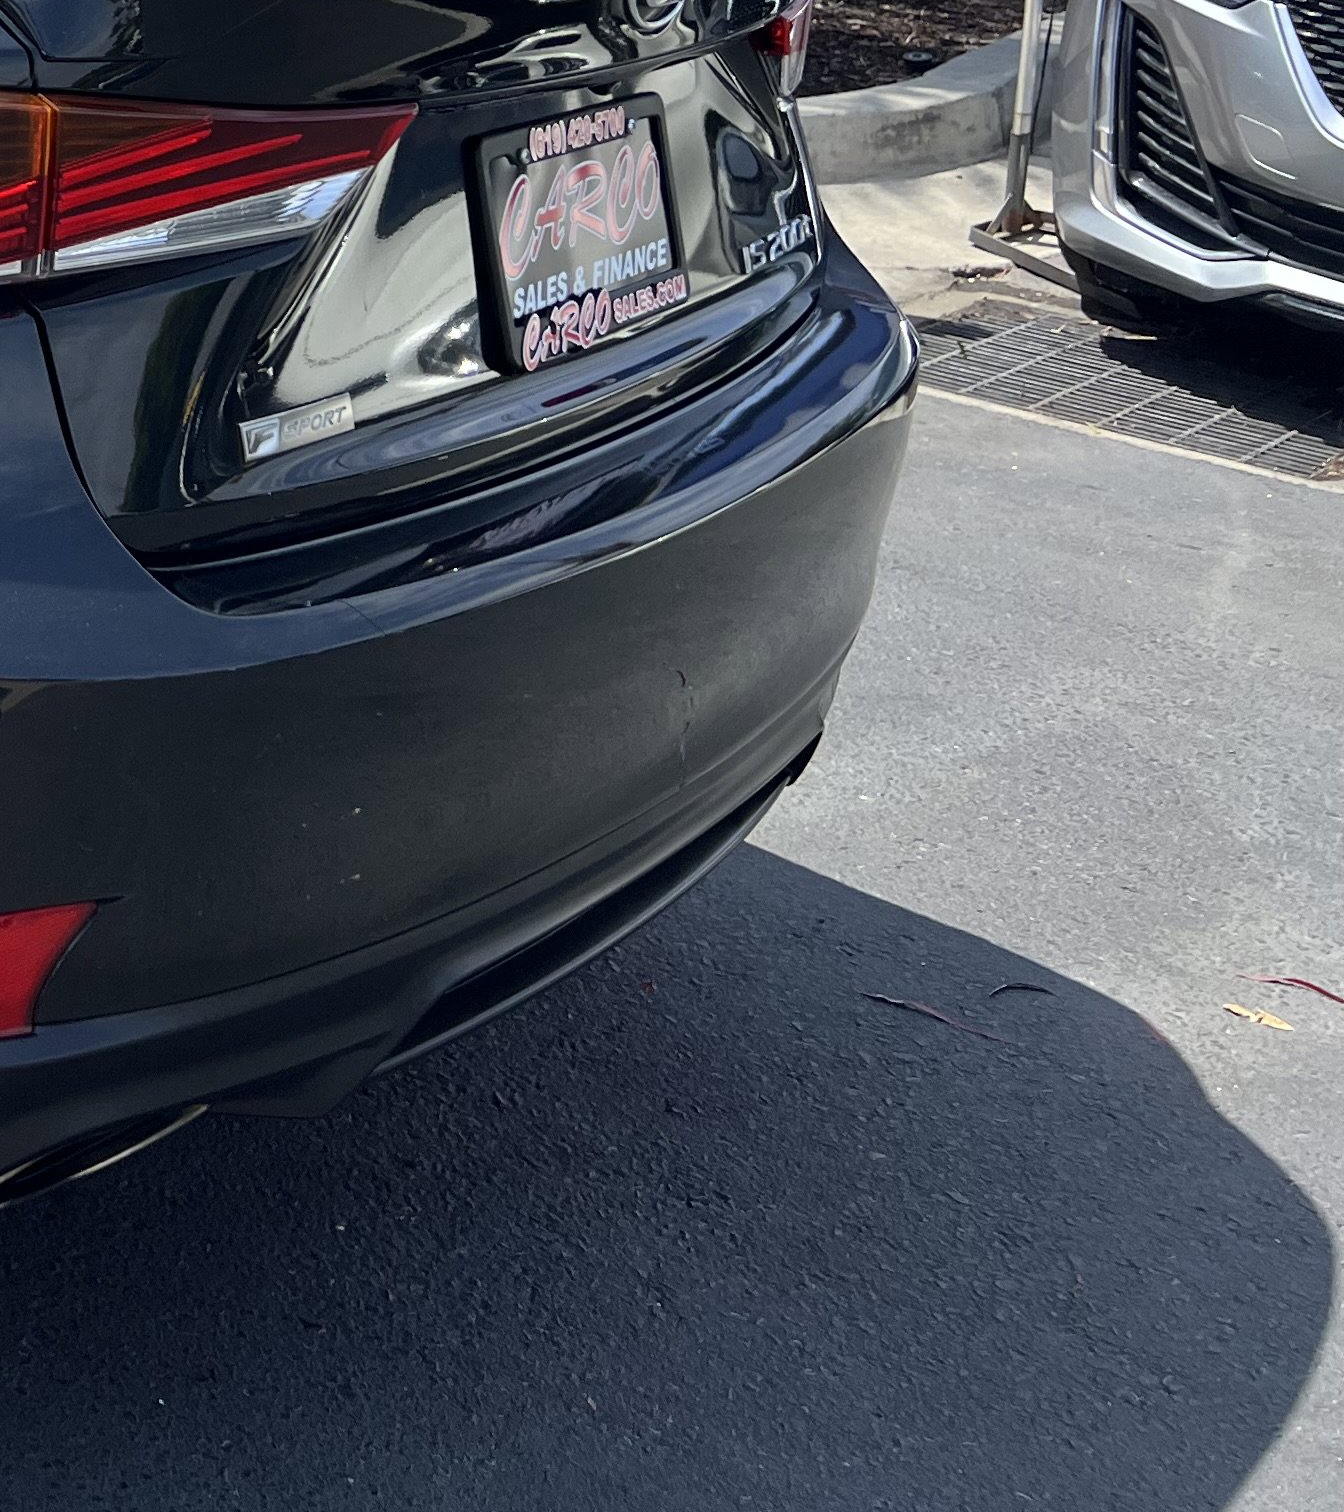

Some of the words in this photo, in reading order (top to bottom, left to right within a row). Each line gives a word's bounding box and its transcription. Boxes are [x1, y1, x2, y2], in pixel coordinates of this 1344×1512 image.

[529, 120, 567, 162] (619)
[499, 140, 661, 281] CARCO
[513, 271, 569, 319] SALES
[573, 265, 588, 297] &
[592, 238, 669, 289] FINANCE
[522, 288, 612, 372] CARCO
[282, 405, 347, 441] SPORT
